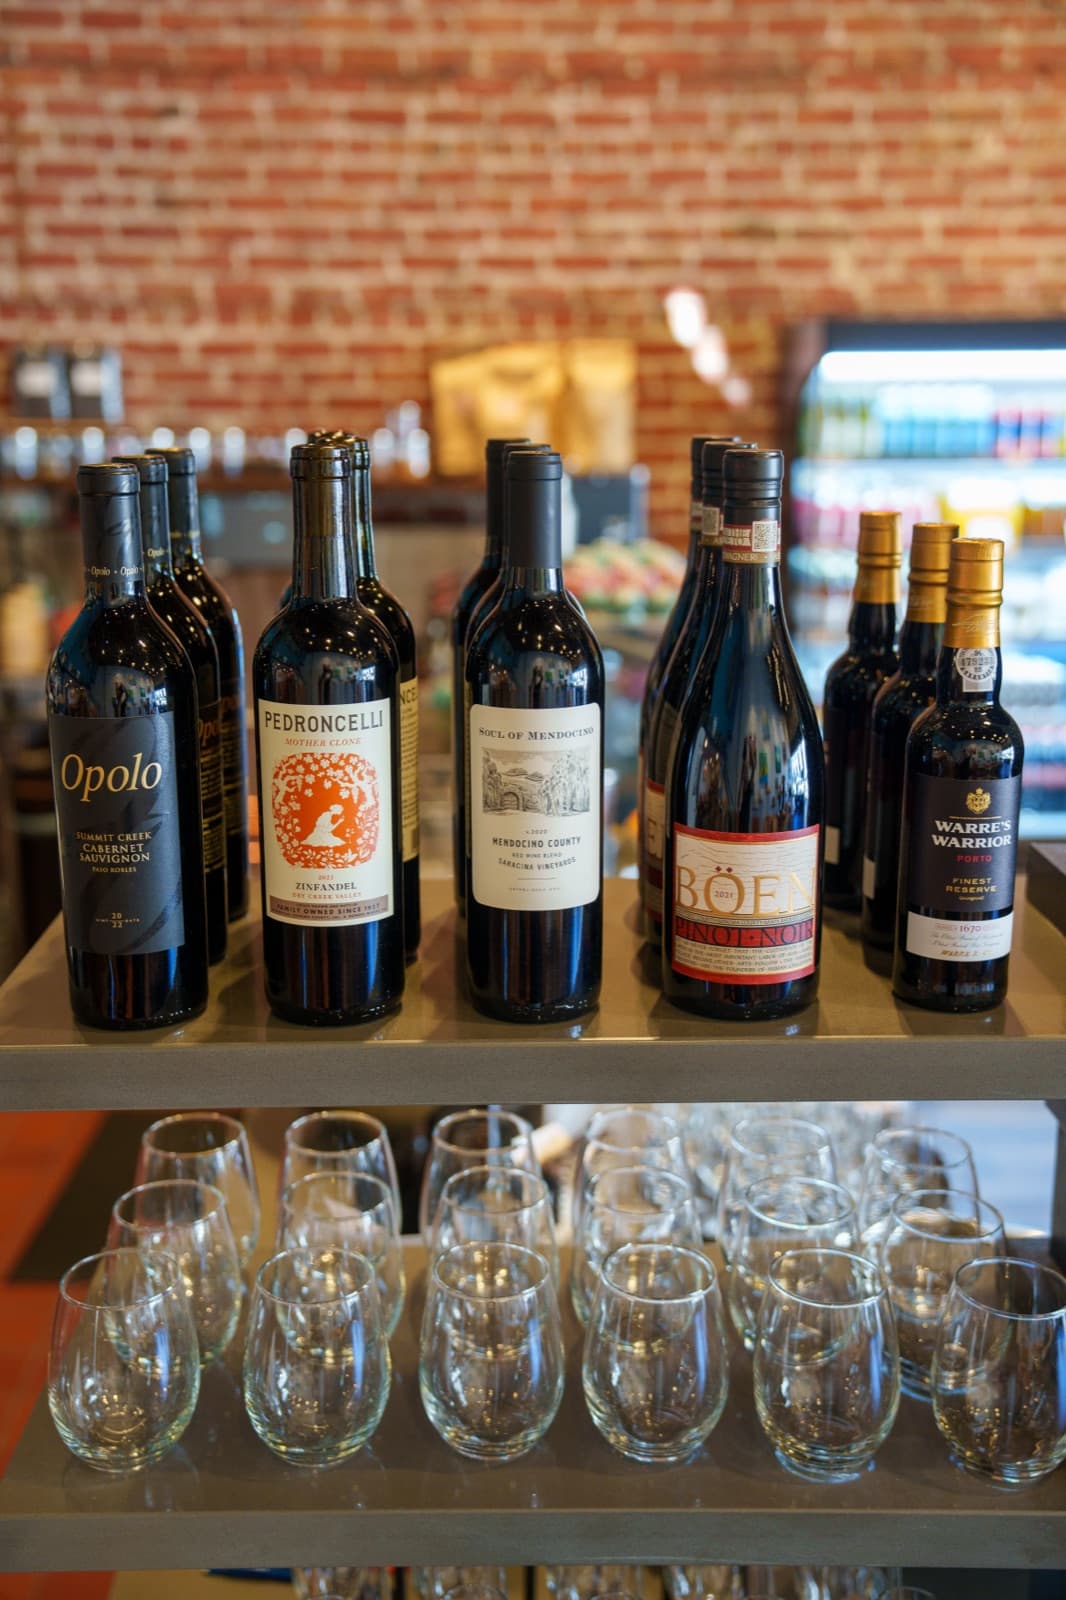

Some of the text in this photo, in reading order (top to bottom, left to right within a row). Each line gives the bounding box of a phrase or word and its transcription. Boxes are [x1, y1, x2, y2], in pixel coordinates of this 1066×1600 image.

[265, 710, 384, 733] PEDRONCELLI
[479, 726, 594, 741] SOUL OF MENDOCINO
[285, 737, 361, 748] MOTHER CLONE
[61, 752, 162, 802] Opolo
[935, 819, 1012, 834] WARRE'S
[75, 831, 152, 842] SUMMIT CREEK
[492, 836, 581, 849] MENDOCINO COUNTY
[931, 834, 1012, 849] WARRIOR
[82, 843, 145, 854] CABERNET
[79, 852, 151, 864] SAUVIGNON
[498, 856, 577, 871] SARACINA VINEYARDS
[956, 854, 993, 864] PORTO
[295, 881, 358, 892] ZINFANDEL
[952, 876, 993, 885] FINEST
[675, 865, 816, 918] BÖEN
[945, 884, 998, 894] RESERVE
[303, 907, 334, 916] OWNED
[337, 906, 361, 915] SINCE
[676, 915, 747, 948] PINOT
[759, 917, 813, 948] NOIR
